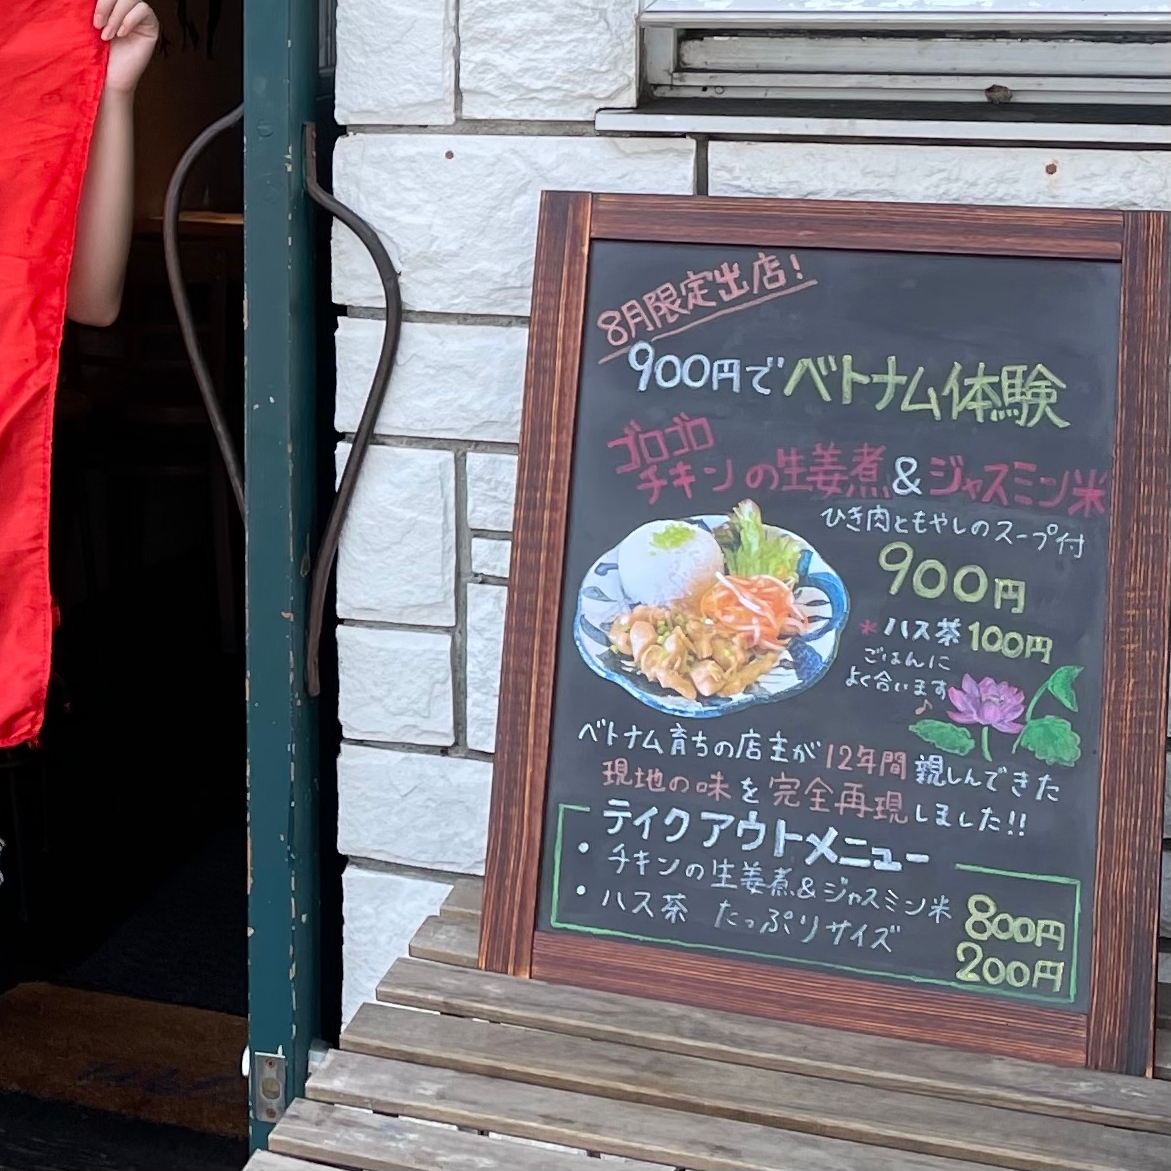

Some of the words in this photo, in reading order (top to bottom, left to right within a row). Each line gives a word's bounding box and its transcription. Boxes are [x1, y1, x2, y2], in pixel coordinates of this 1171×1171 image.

[607, 412, 715, 475] ゴロゴロ
[820, 504, 1086, 559] ひき肉ともやしのスープ付
[878, 540, 1026, 614] 900円
[883, 617, 961, 647] ハス茶
[967, 621, 1053, 665] 100円
[601, 889, 690, 925] ハス茶
[955, 941, 1065, 993] 200円
[964, 893, 1066, 952] 800円
